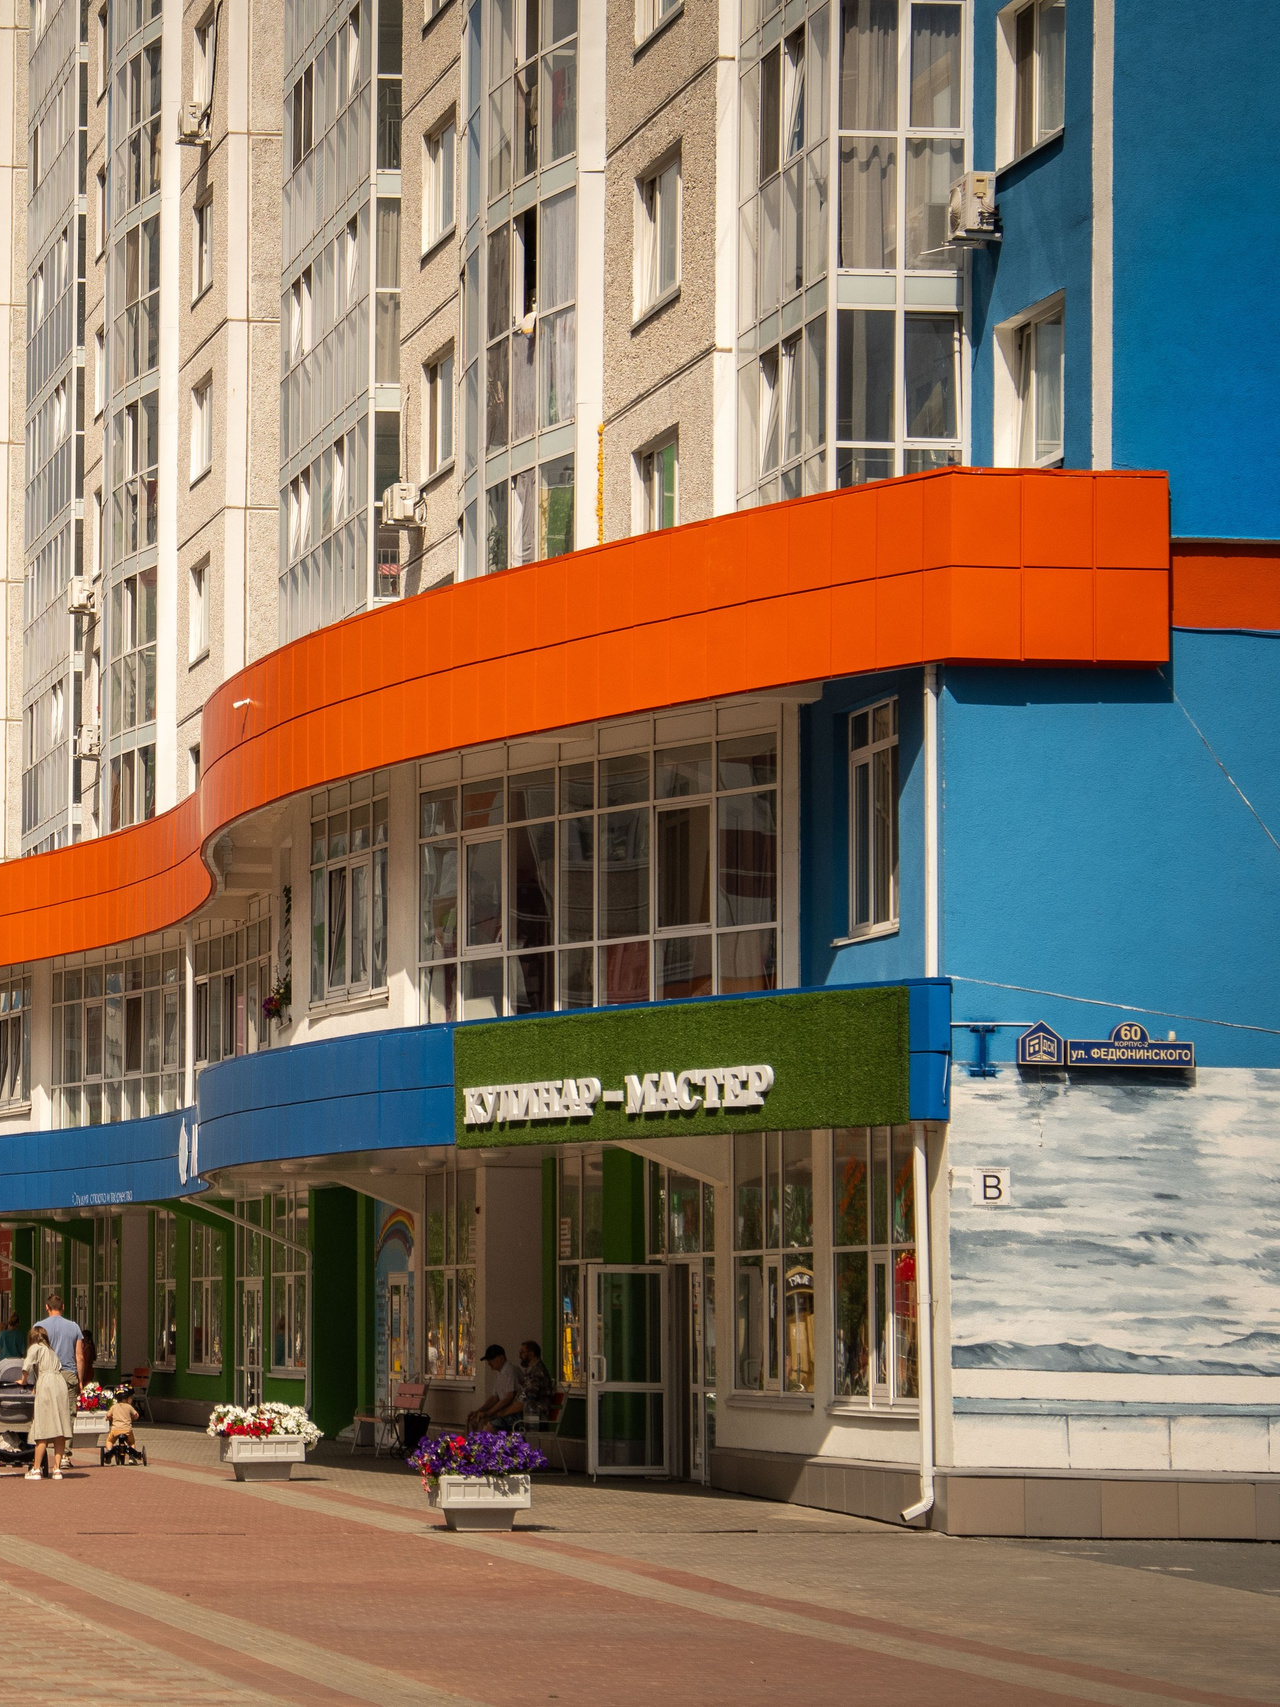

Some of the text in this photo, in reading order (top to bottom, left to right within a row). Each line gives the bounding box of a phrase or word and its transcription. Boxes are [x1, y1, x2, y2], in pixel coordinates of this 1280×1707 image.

[1120, 1026, 1141, 1041] 60
[1071, 1048, 1191, 1060] ул. ФЕДЮНИНСКОГО
[463, 1064, 775, 1124] КУЛИНАР-МАСТЕР
